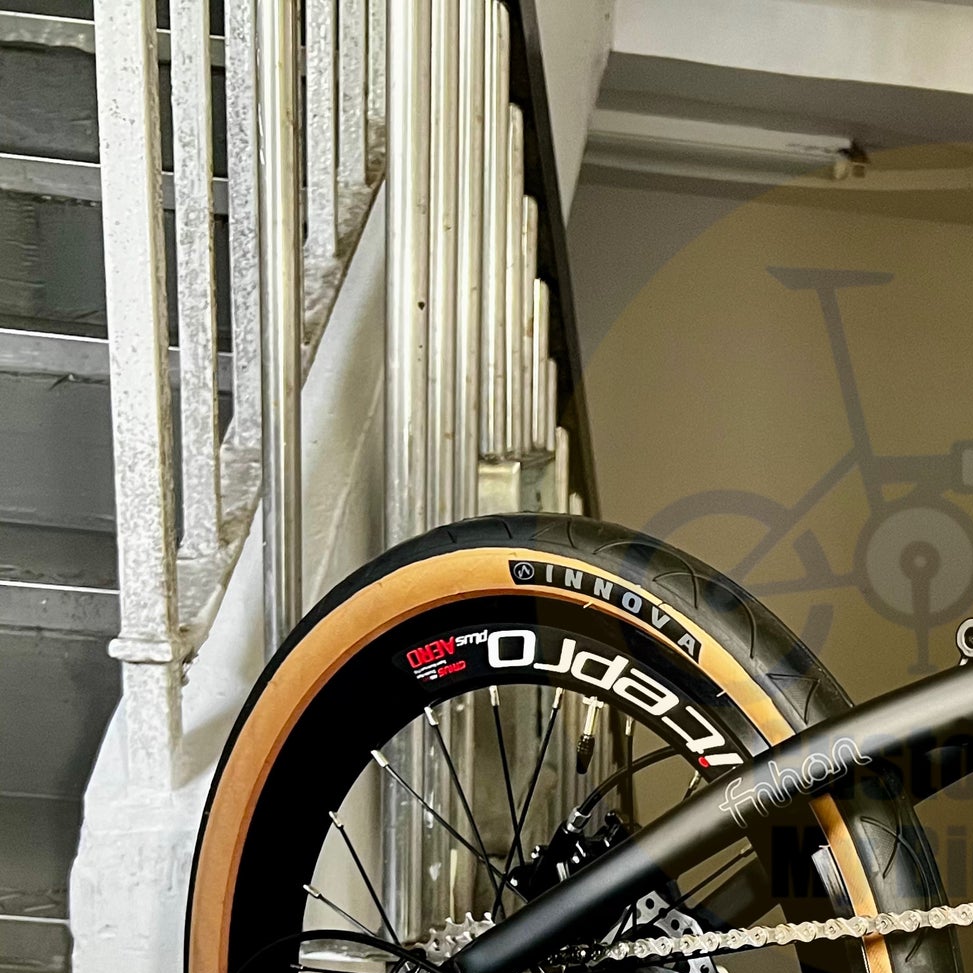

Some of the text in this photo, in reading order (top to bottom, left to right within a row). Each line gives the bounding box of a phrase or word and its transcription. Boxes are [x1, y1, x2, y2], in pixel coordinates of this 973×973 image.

[406, 636, 454, 668] AERO
[545, 564, 696, 656] INNOVA
[487, 629, 743, 768] itepro
[719, 737, 873, 828] fnhon
